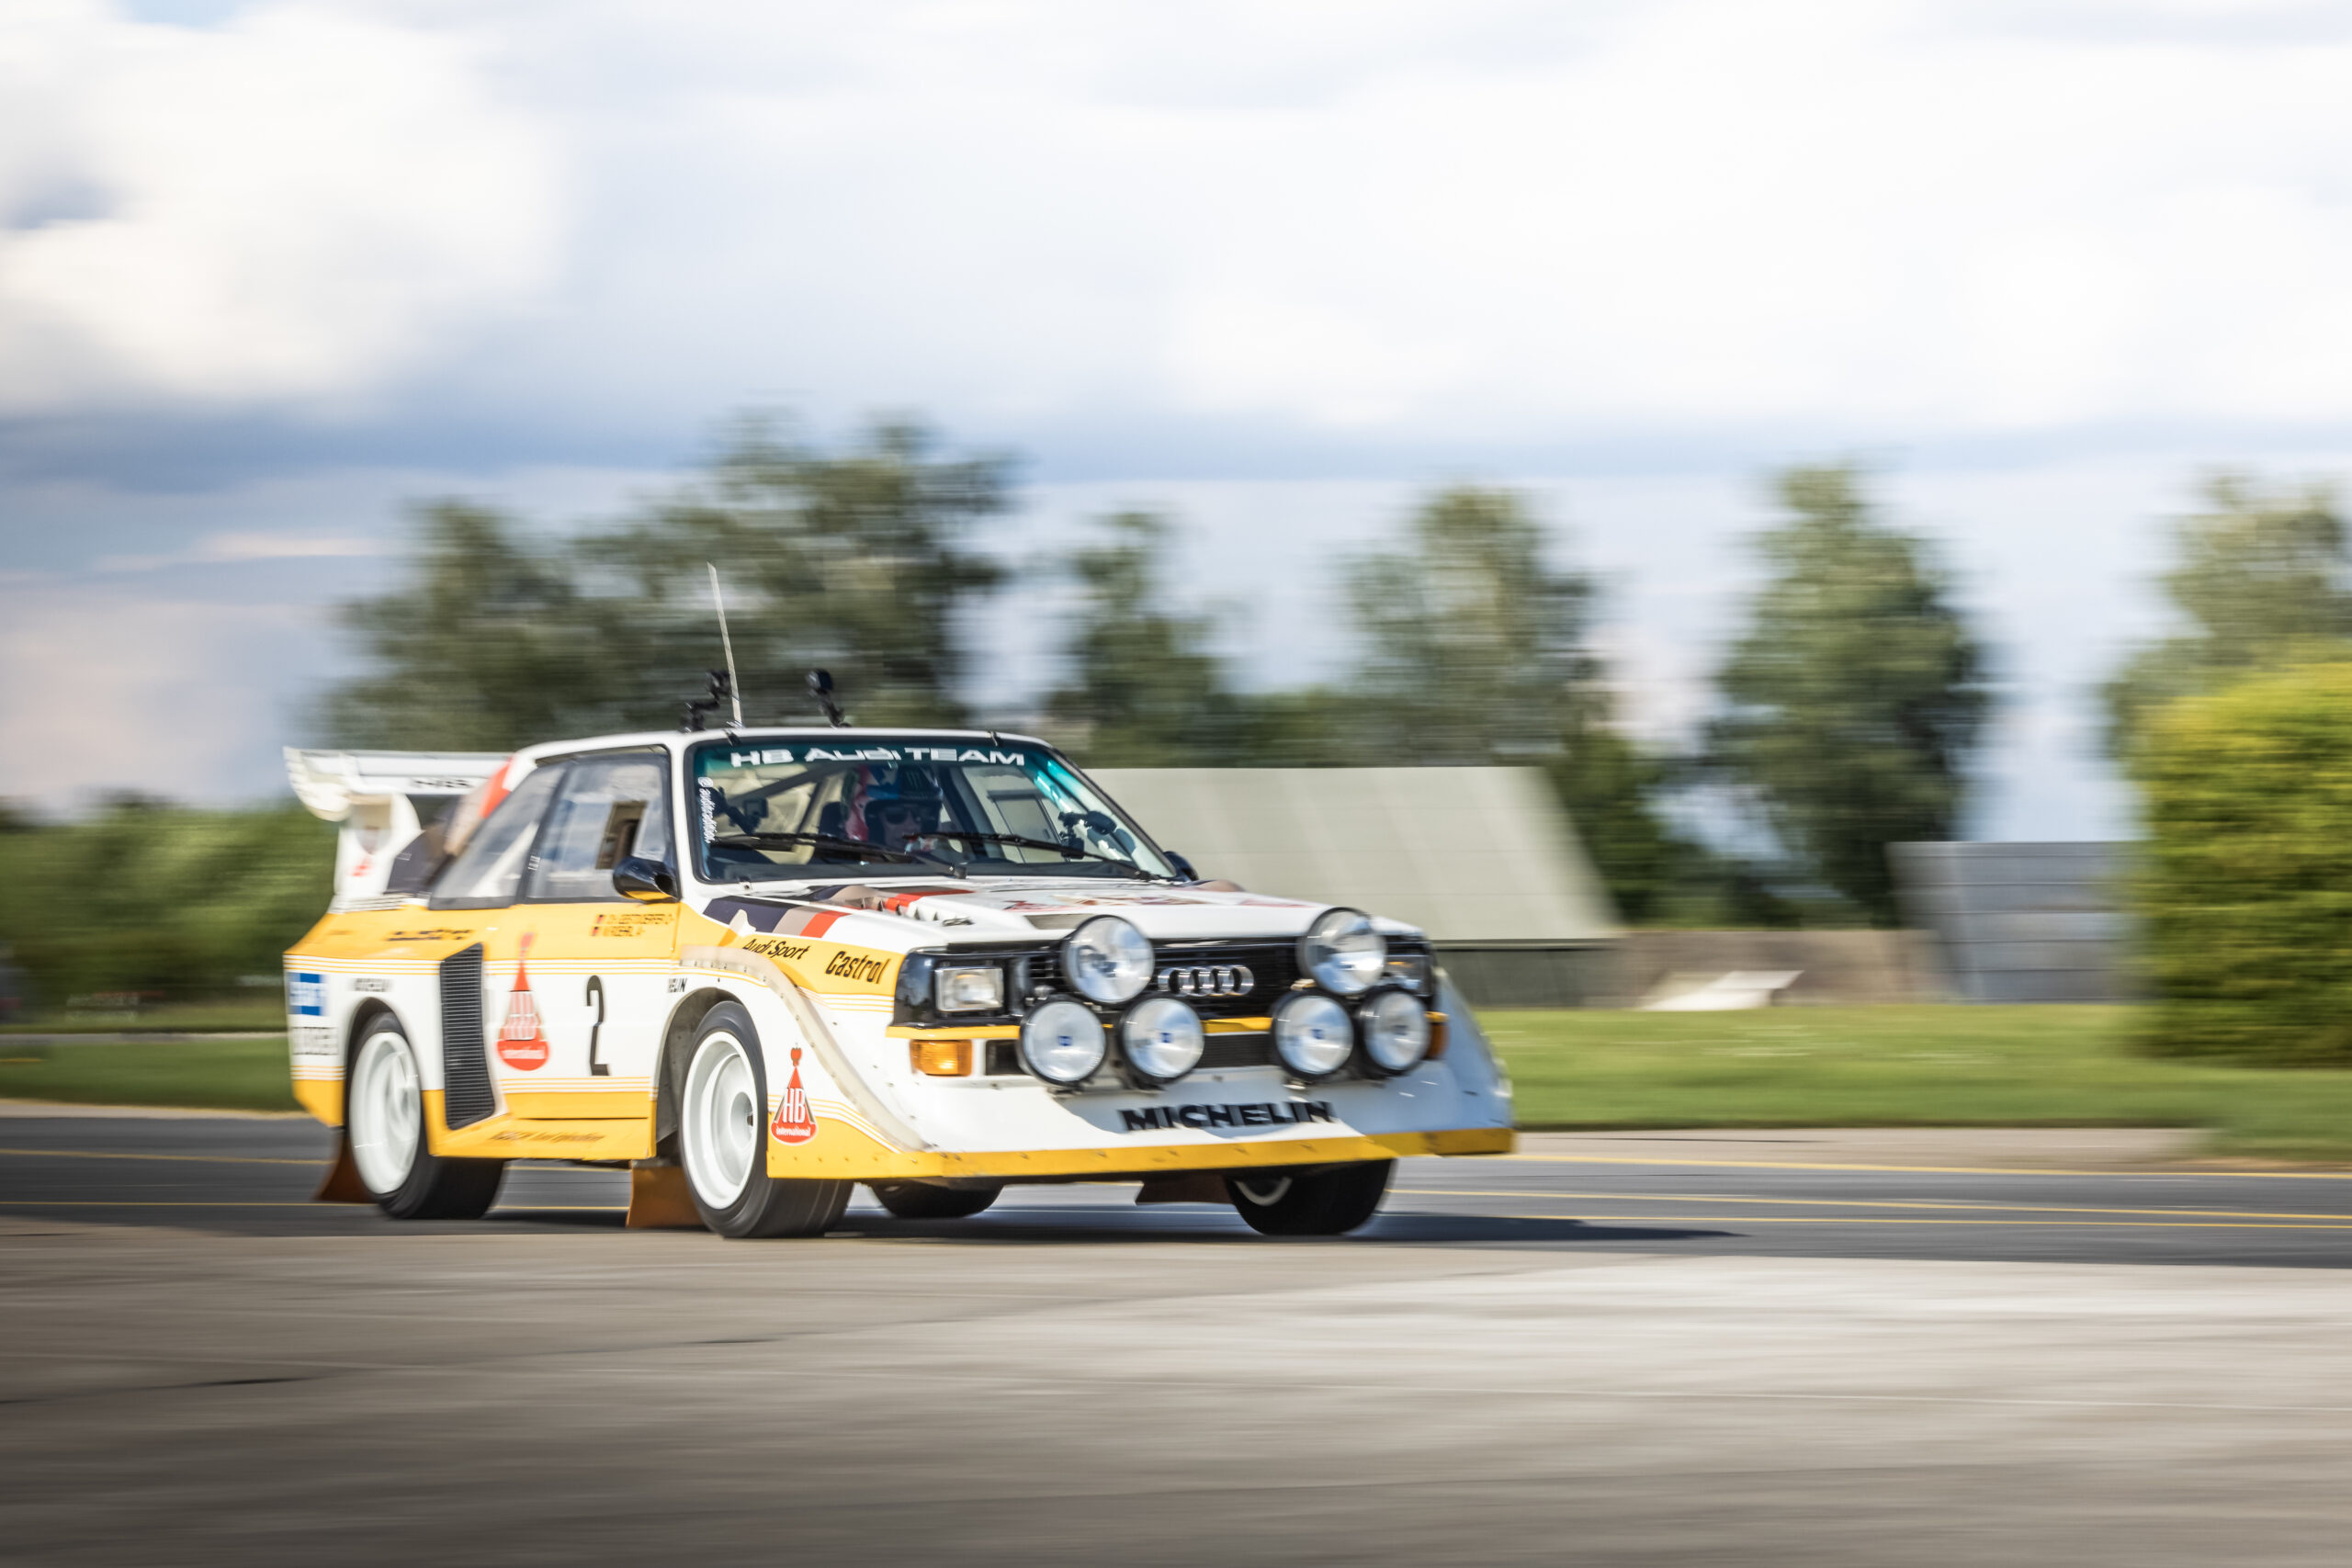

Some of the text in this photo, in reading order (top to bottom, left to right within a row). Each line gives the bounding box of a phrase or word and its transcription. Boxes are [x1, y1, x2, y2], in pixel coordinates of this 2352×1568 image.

[730, 749, 794, 767] HB
[904, 747, 1024, 766] TEAM
[742, 939, 810, 959] Audi Sport
[825, 951, 891, 984] Castrol
[586, 975, 610, 1076] 2
[782, 1088, 806, 1123] HB
[1119, 1101, 1338, 1131] MICHELIN
